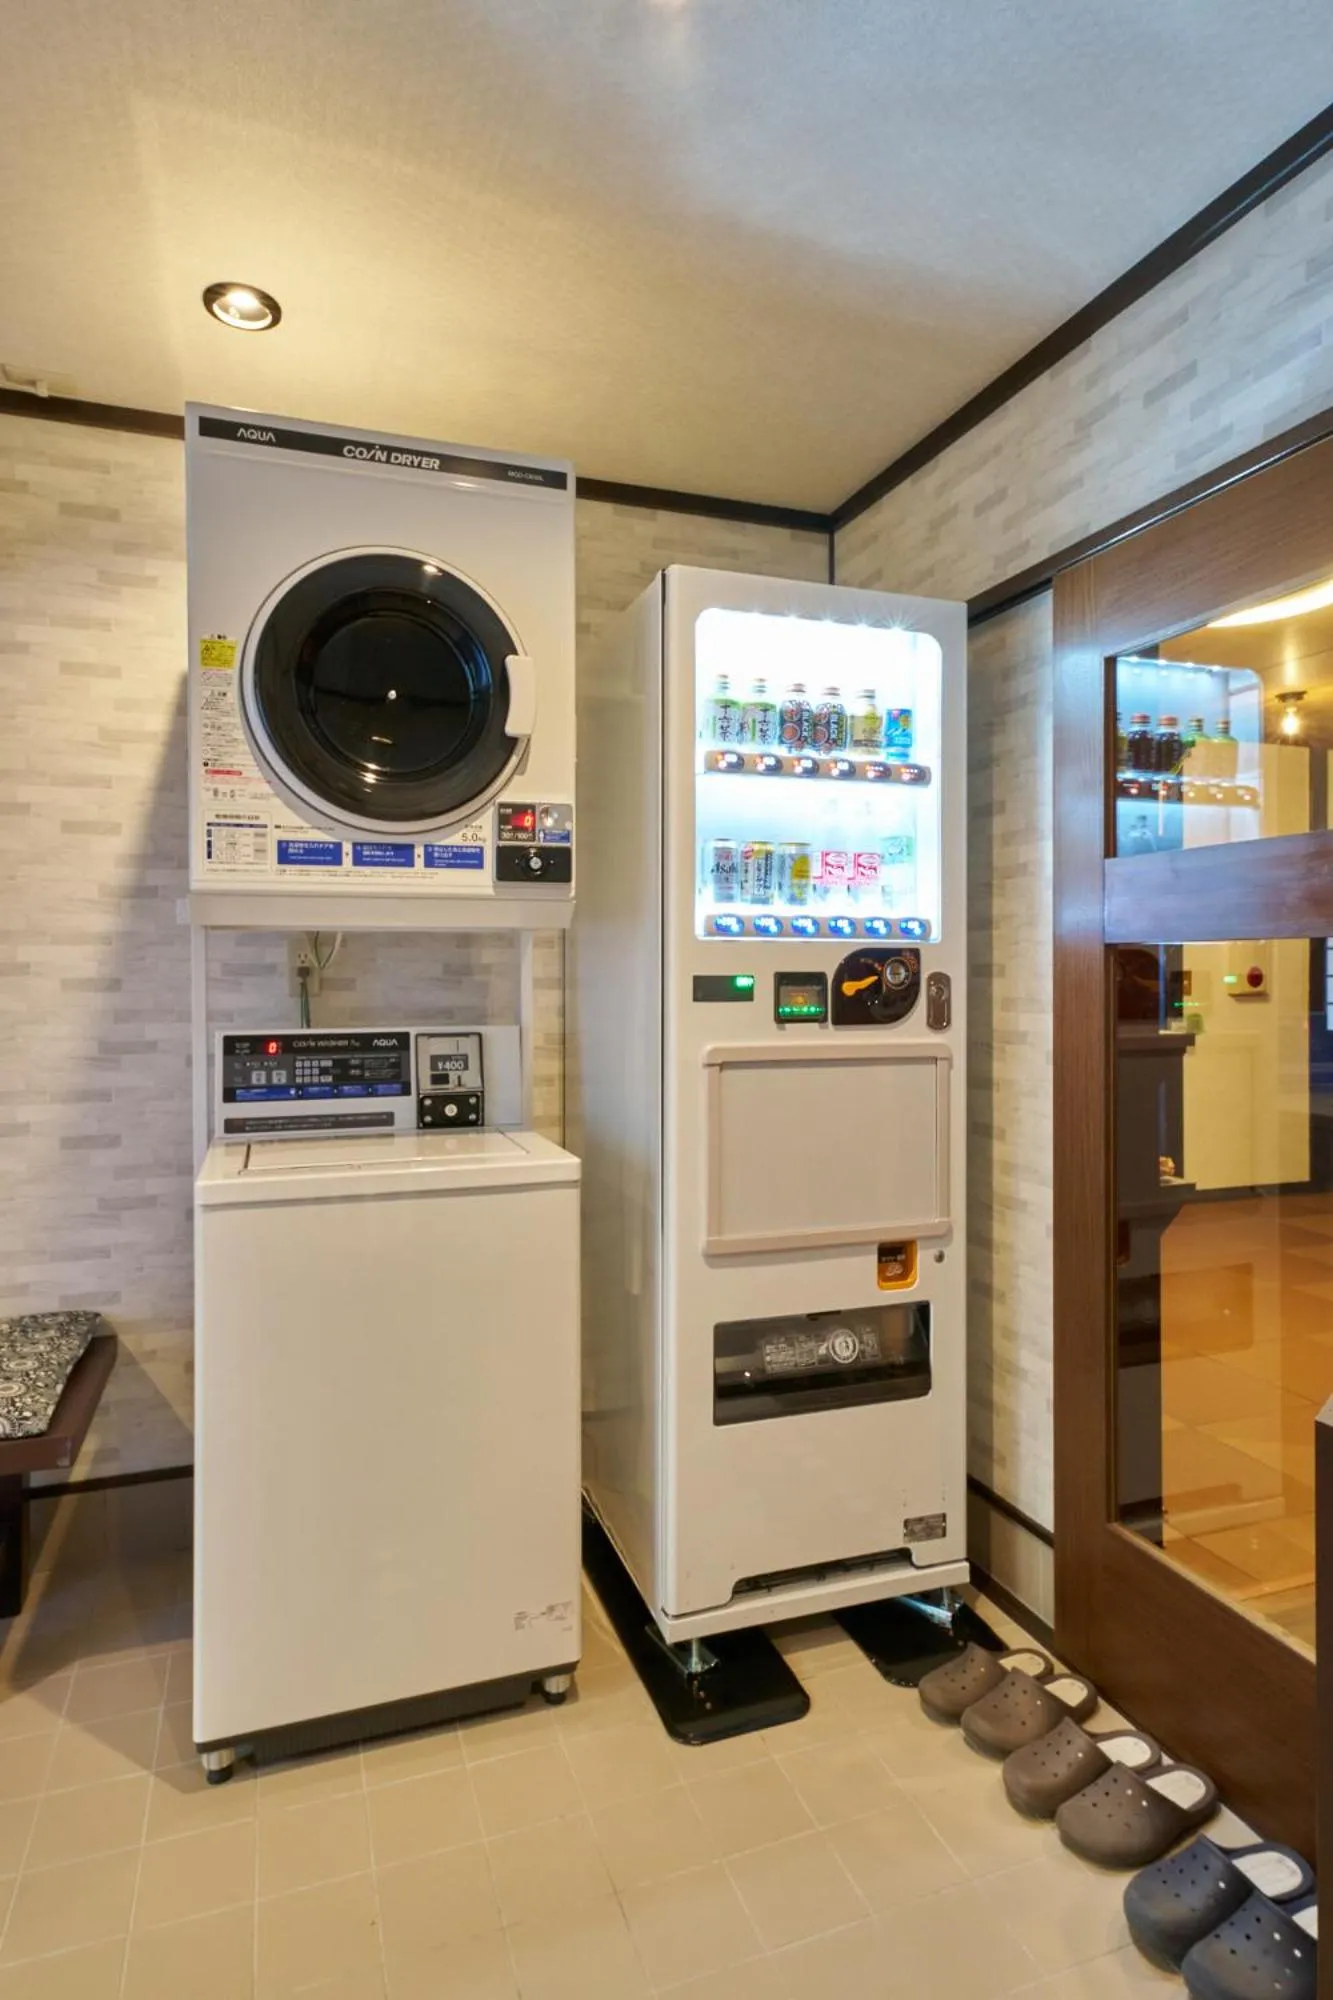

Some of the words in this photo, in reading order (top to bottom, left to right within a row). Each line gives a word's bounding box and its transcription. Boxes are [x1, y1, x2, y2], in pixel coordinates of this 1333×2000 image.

[236, 427, 276, 443] AQUA
[342, 445, 388, 463] COIN
[390, 453, 441, 471] DRYER
[372, 1037, 399, 1047] AQUA
